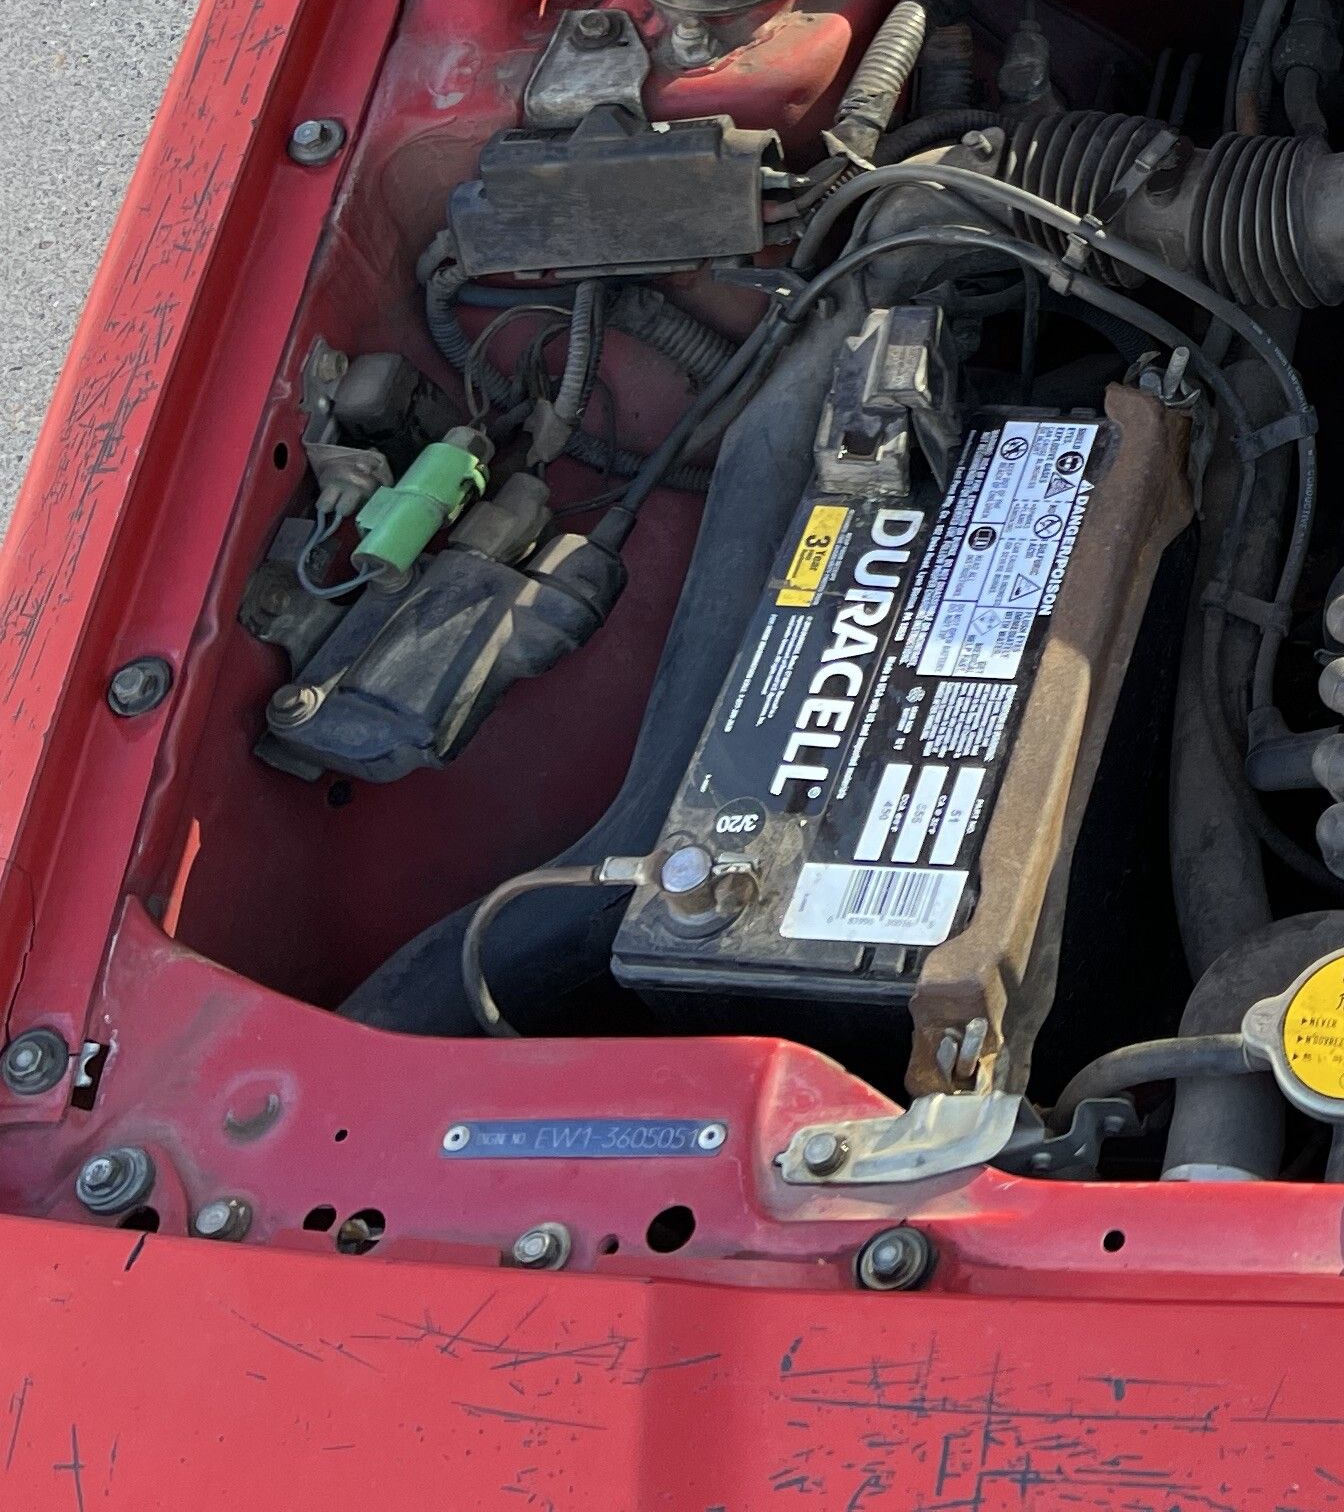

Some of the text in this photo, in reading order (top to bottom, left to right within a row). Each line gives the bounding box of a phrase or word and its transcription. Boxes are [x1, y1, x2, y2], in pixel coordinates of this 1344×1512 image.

[803, 535, 832, 547] 3
[1037, 495, 1089, 615] DANGER/POISON
[769, 509, 925, 797] DURACELL
[716, 813, 758, 833] 3/20
[1309, 1017, 1337, 1028] NEVER
